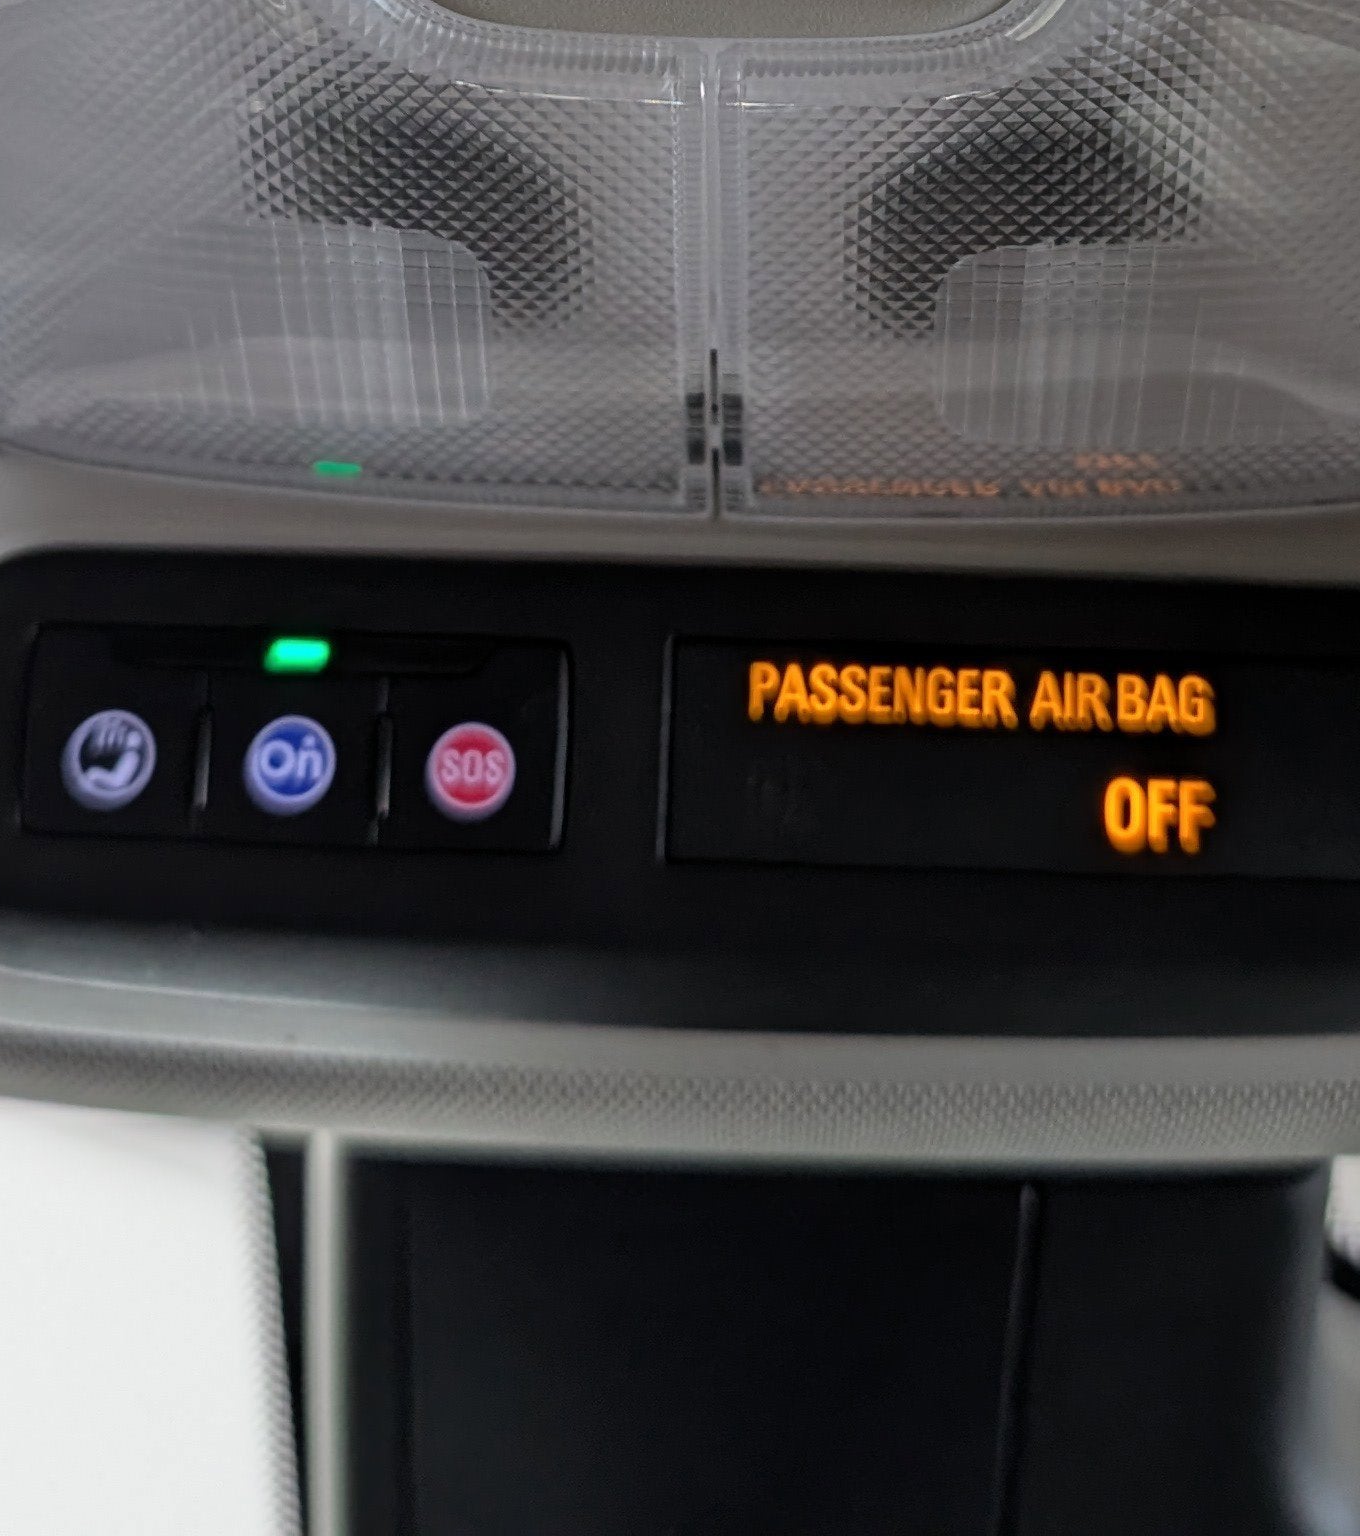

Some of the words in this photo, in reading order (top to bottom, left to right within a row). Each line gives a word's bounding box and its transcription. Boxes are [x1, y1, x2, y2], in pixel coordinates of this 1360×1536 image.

[748, 660, 1018, 728] PASSENGER
[1028, 669, 1112, 732] AIR
[1115, 673, 1217, 736] BAG
[442, 750, 504, 786] SOS
[1103, 775, 1217, 855] OFF
